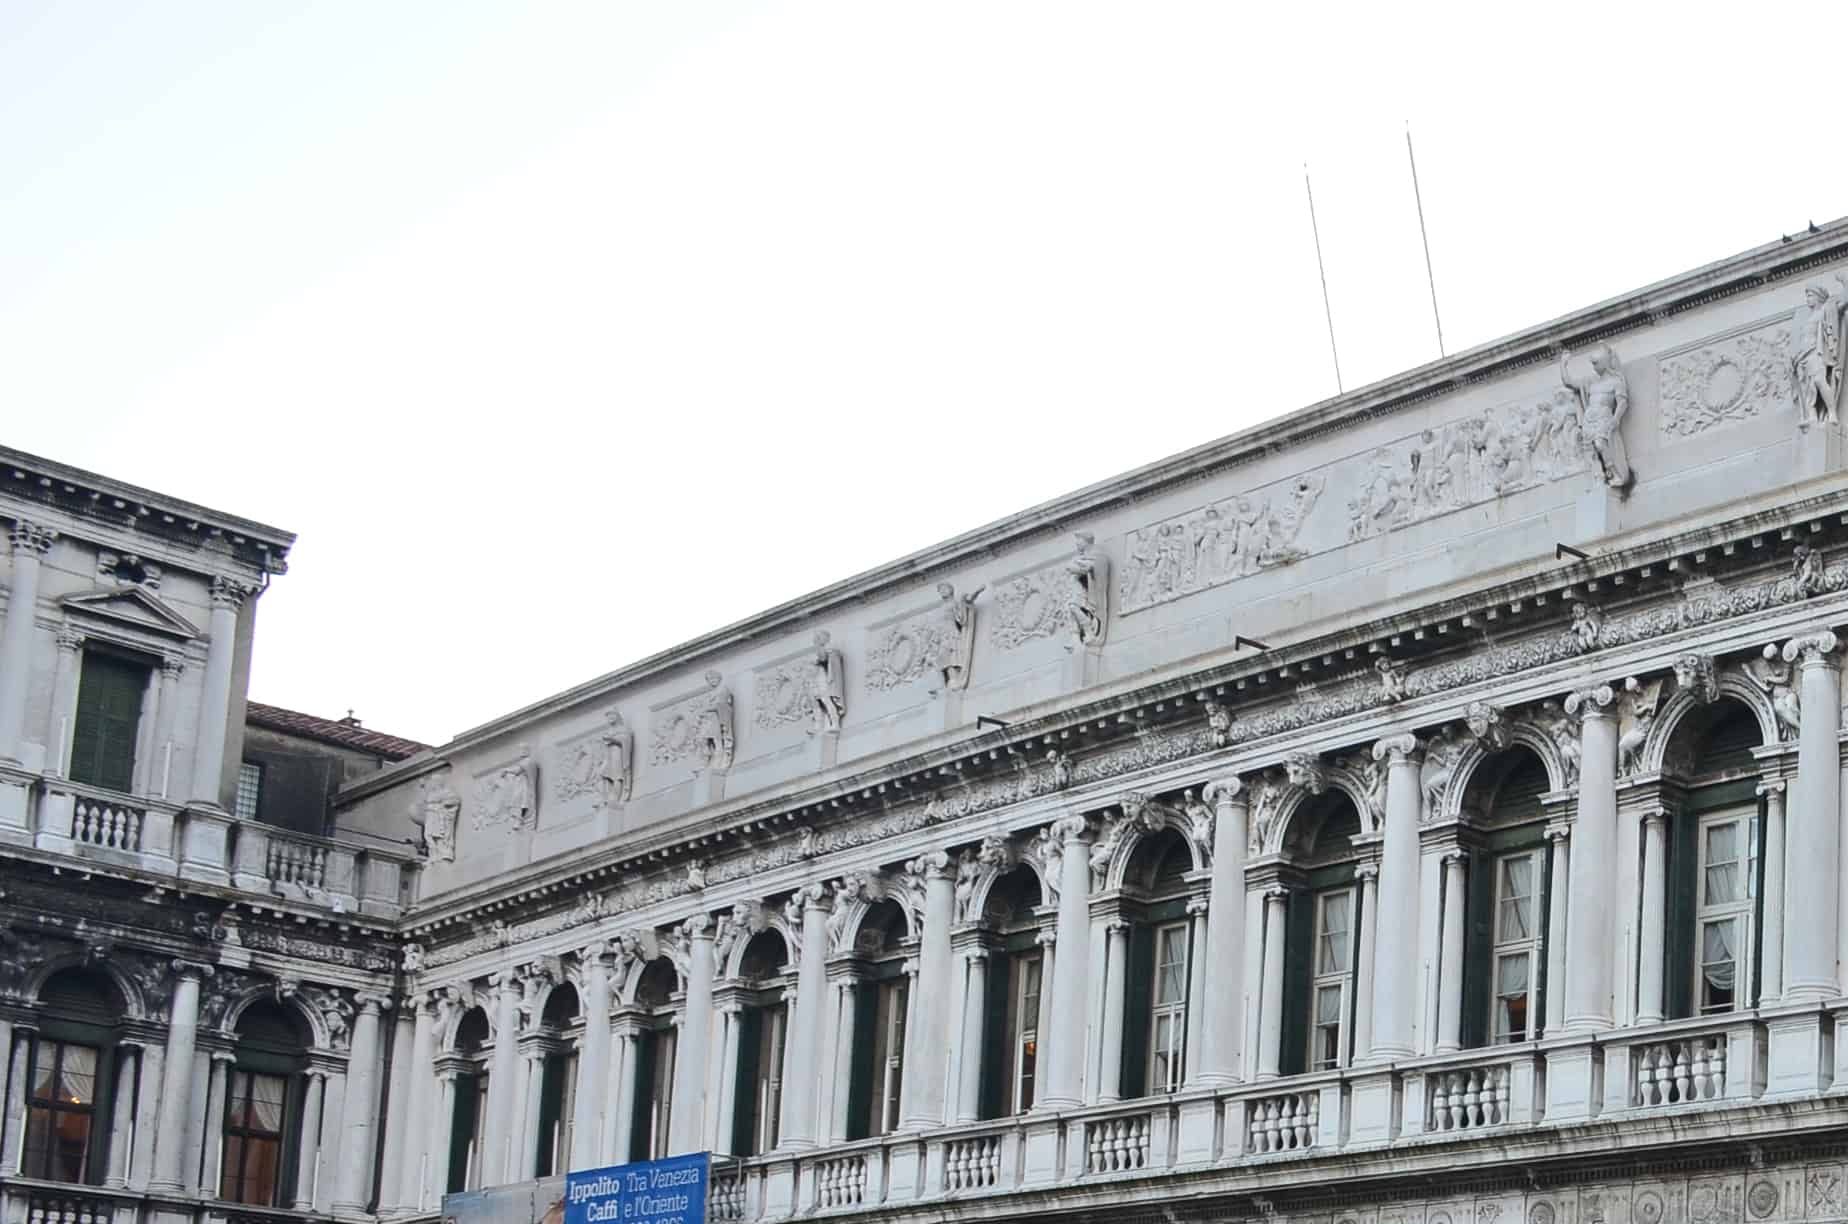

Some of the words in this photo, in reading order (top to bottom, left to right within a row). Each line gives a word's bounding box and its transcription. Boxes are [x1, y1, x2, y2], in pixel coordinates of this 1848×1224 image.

[569, 1175, 620, 1204] Ippolito
[626, 1172, 648, 1193] Tra
[649, 1166, 699, 1189] Venezia
[587, 1200, 618, 1222] Caffi
[623, 1204, 633, 1218] e
